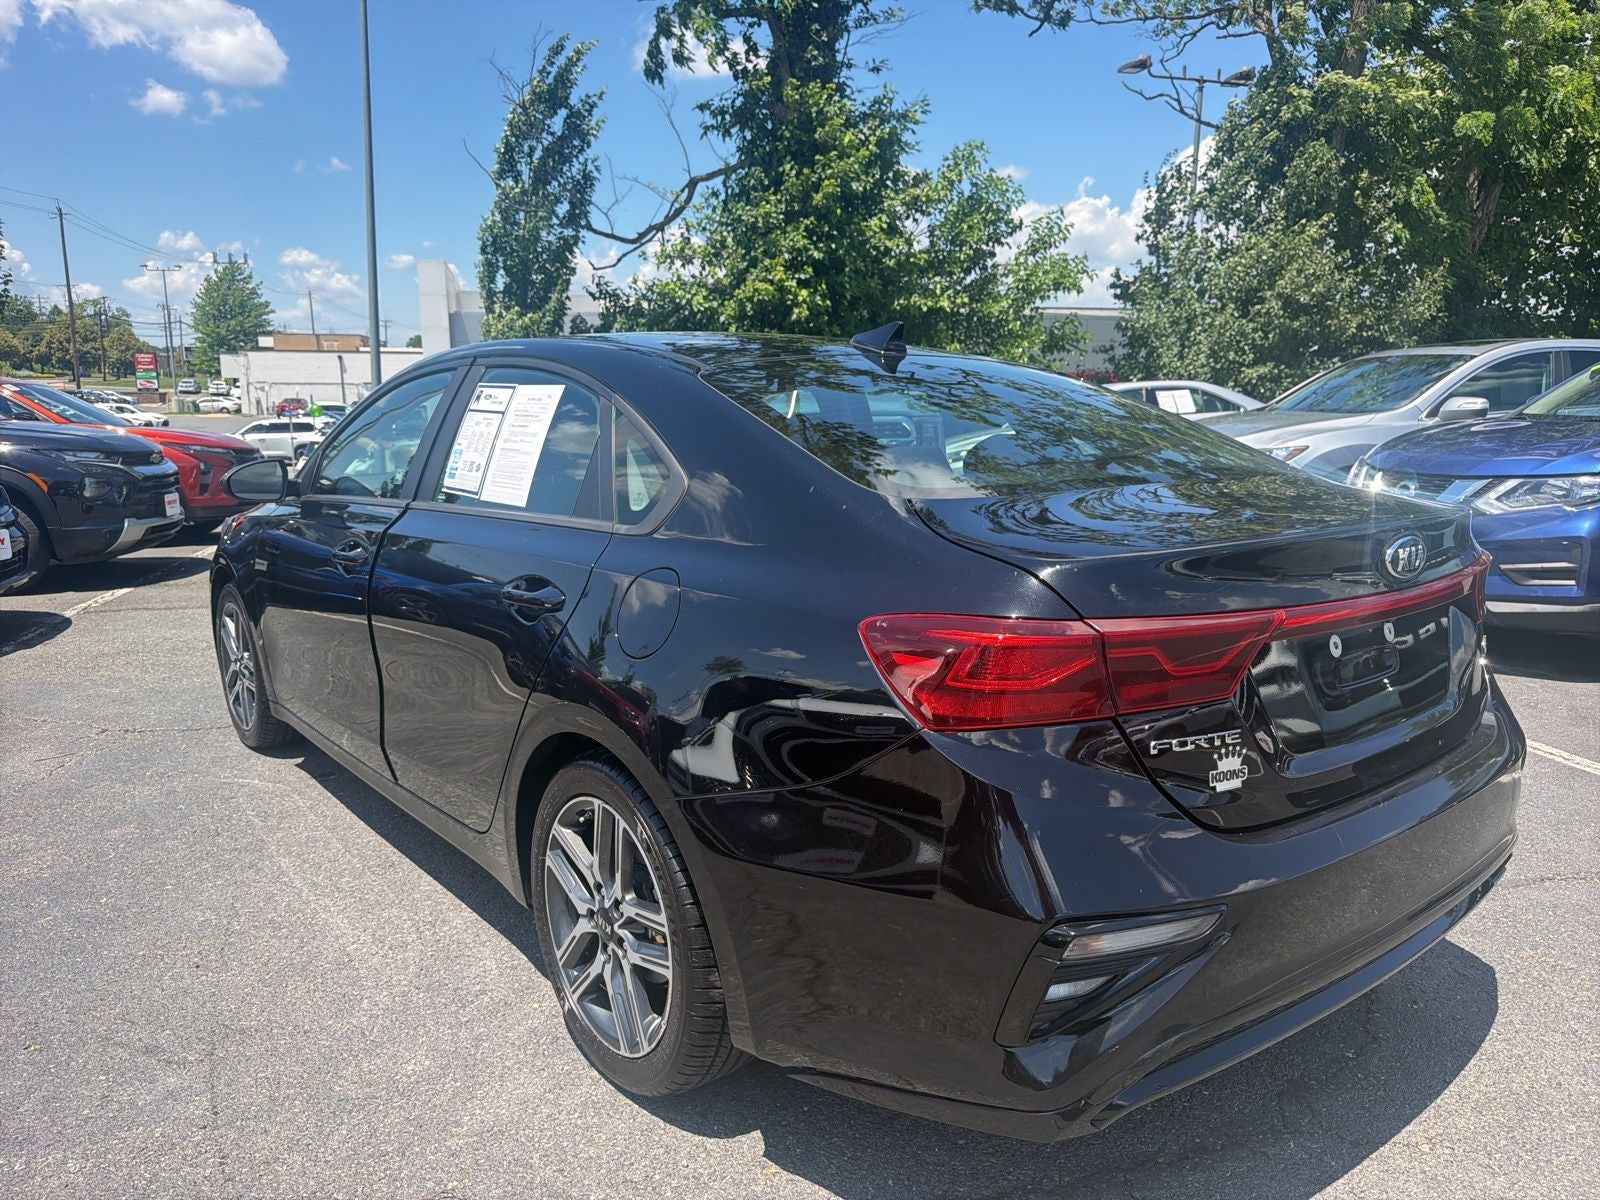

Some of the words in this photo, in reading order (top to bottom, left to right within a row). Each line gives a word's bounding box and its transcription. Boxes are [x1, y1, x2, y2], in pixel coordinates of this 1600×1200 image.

[1397, 545, 1424, 572] KIA
[1150, 729, 1242, 755] FORTE
[1211, 767, 1247, 784] KOONS
